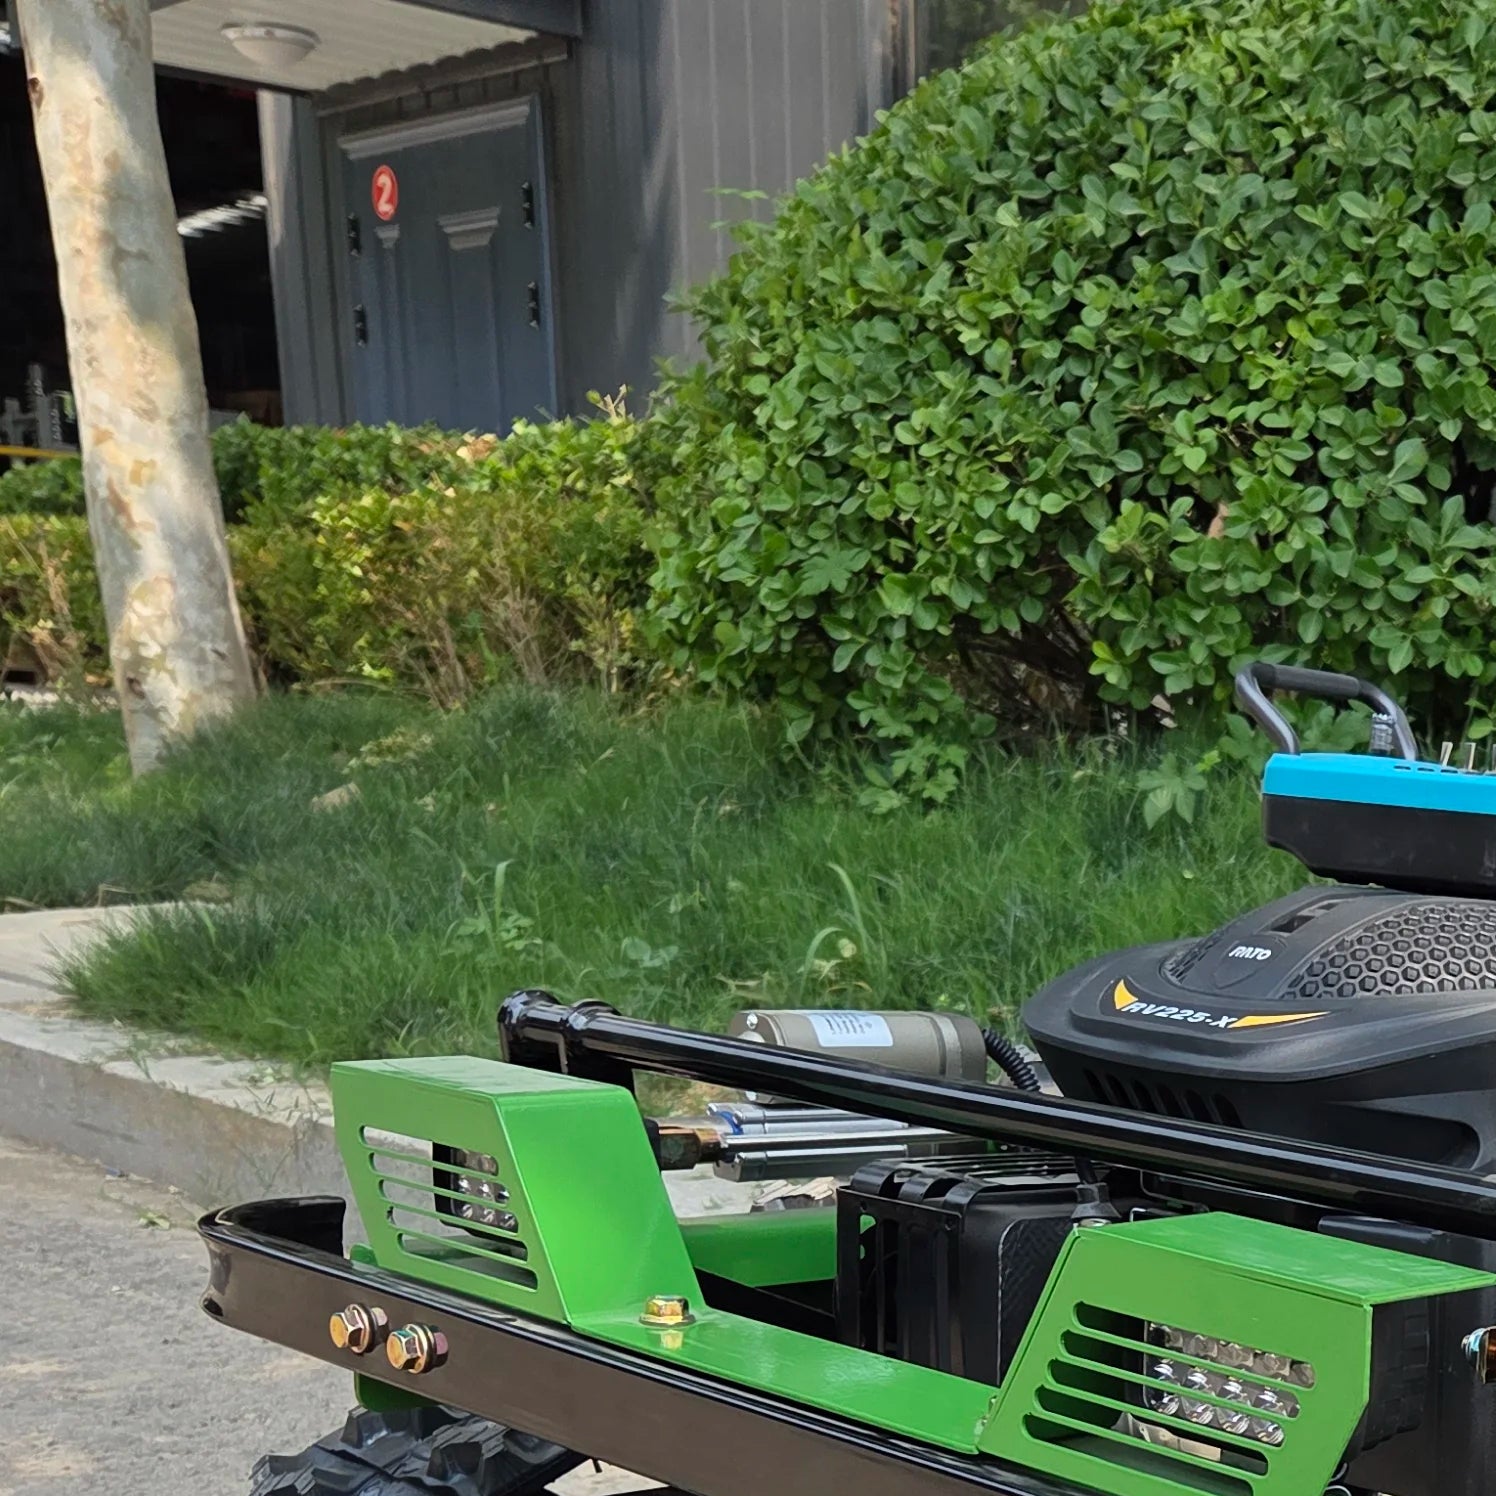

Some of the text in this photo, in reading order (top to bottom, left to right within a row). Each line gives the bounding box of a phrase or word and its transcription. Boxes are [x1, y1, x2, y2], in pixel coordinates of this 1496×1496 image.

[377, 173, 394, 213] 2
[1229, 946, 1272, 961] RATO
[1121, 1002, 1239, 1029] RV225-X
